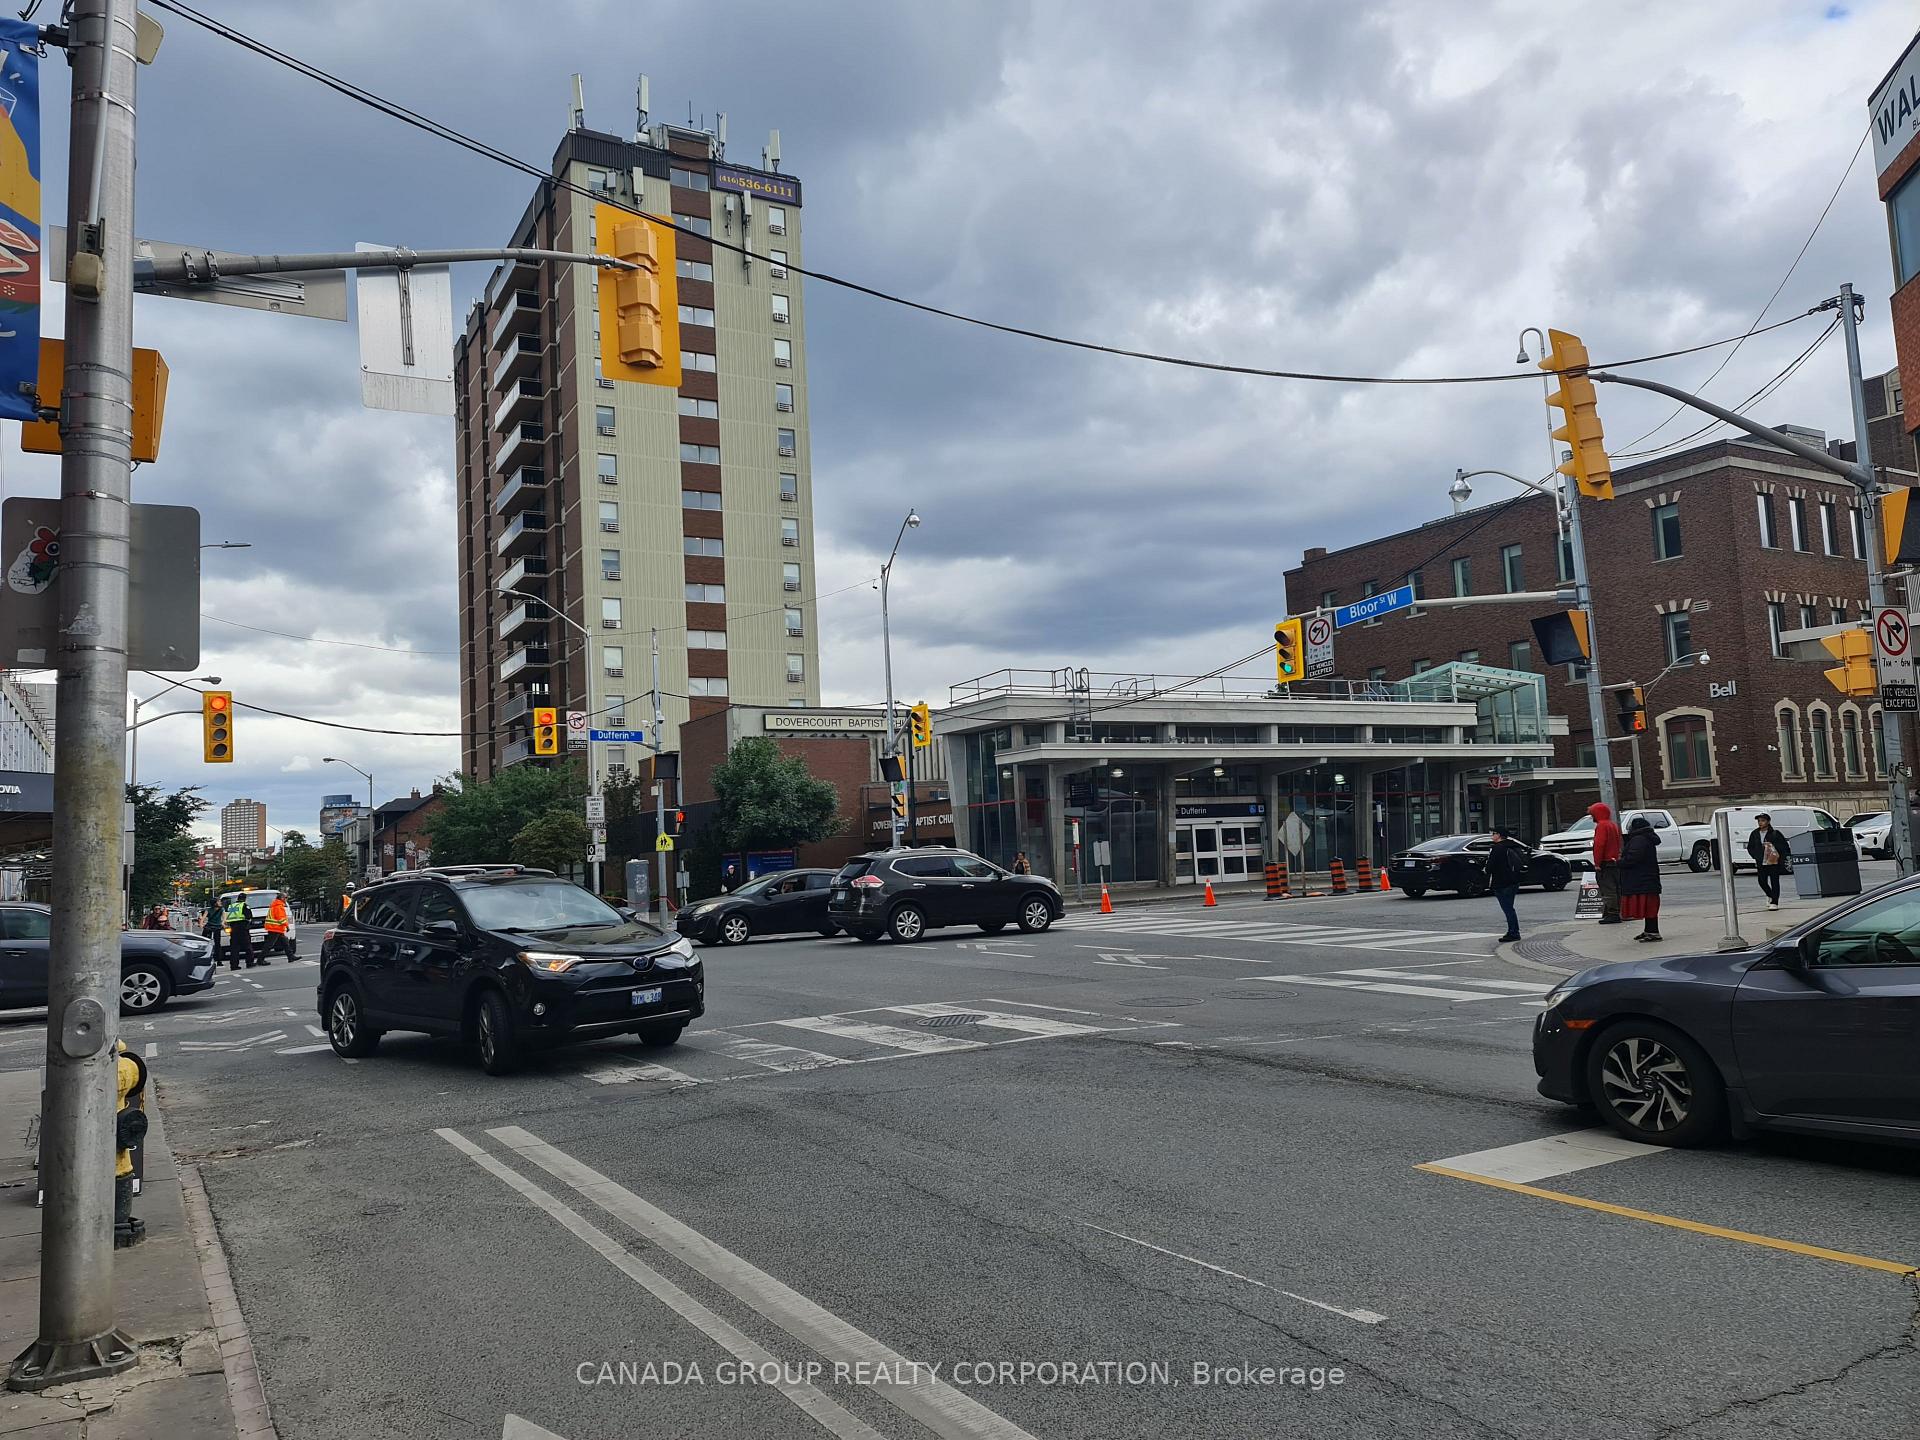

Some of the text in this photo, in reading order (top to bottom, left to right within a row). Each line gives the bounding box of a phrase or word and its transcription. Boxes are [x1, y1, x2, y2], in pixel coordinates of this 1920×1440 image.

[1349, 601, 1378, 618] Bloor
[1387, 592, 1397, 606] W
[1309, 667, 1333, 678] EXCEPTED
[1709, 680, 1737, 698] Bell
[1882, 687, 1916, 697] TTC VEHICLES
[1885, 698, 1916, 708] EXCEPTED
[775, 717, 843, 727] DOVERCOURT
[848, 718, 884, 728] BAPTIST
[597, 731, 630, 740] Dufferin
[1181, 807, 1207, 816] Dufferin
[915, 815, 937, 828] APTIST
